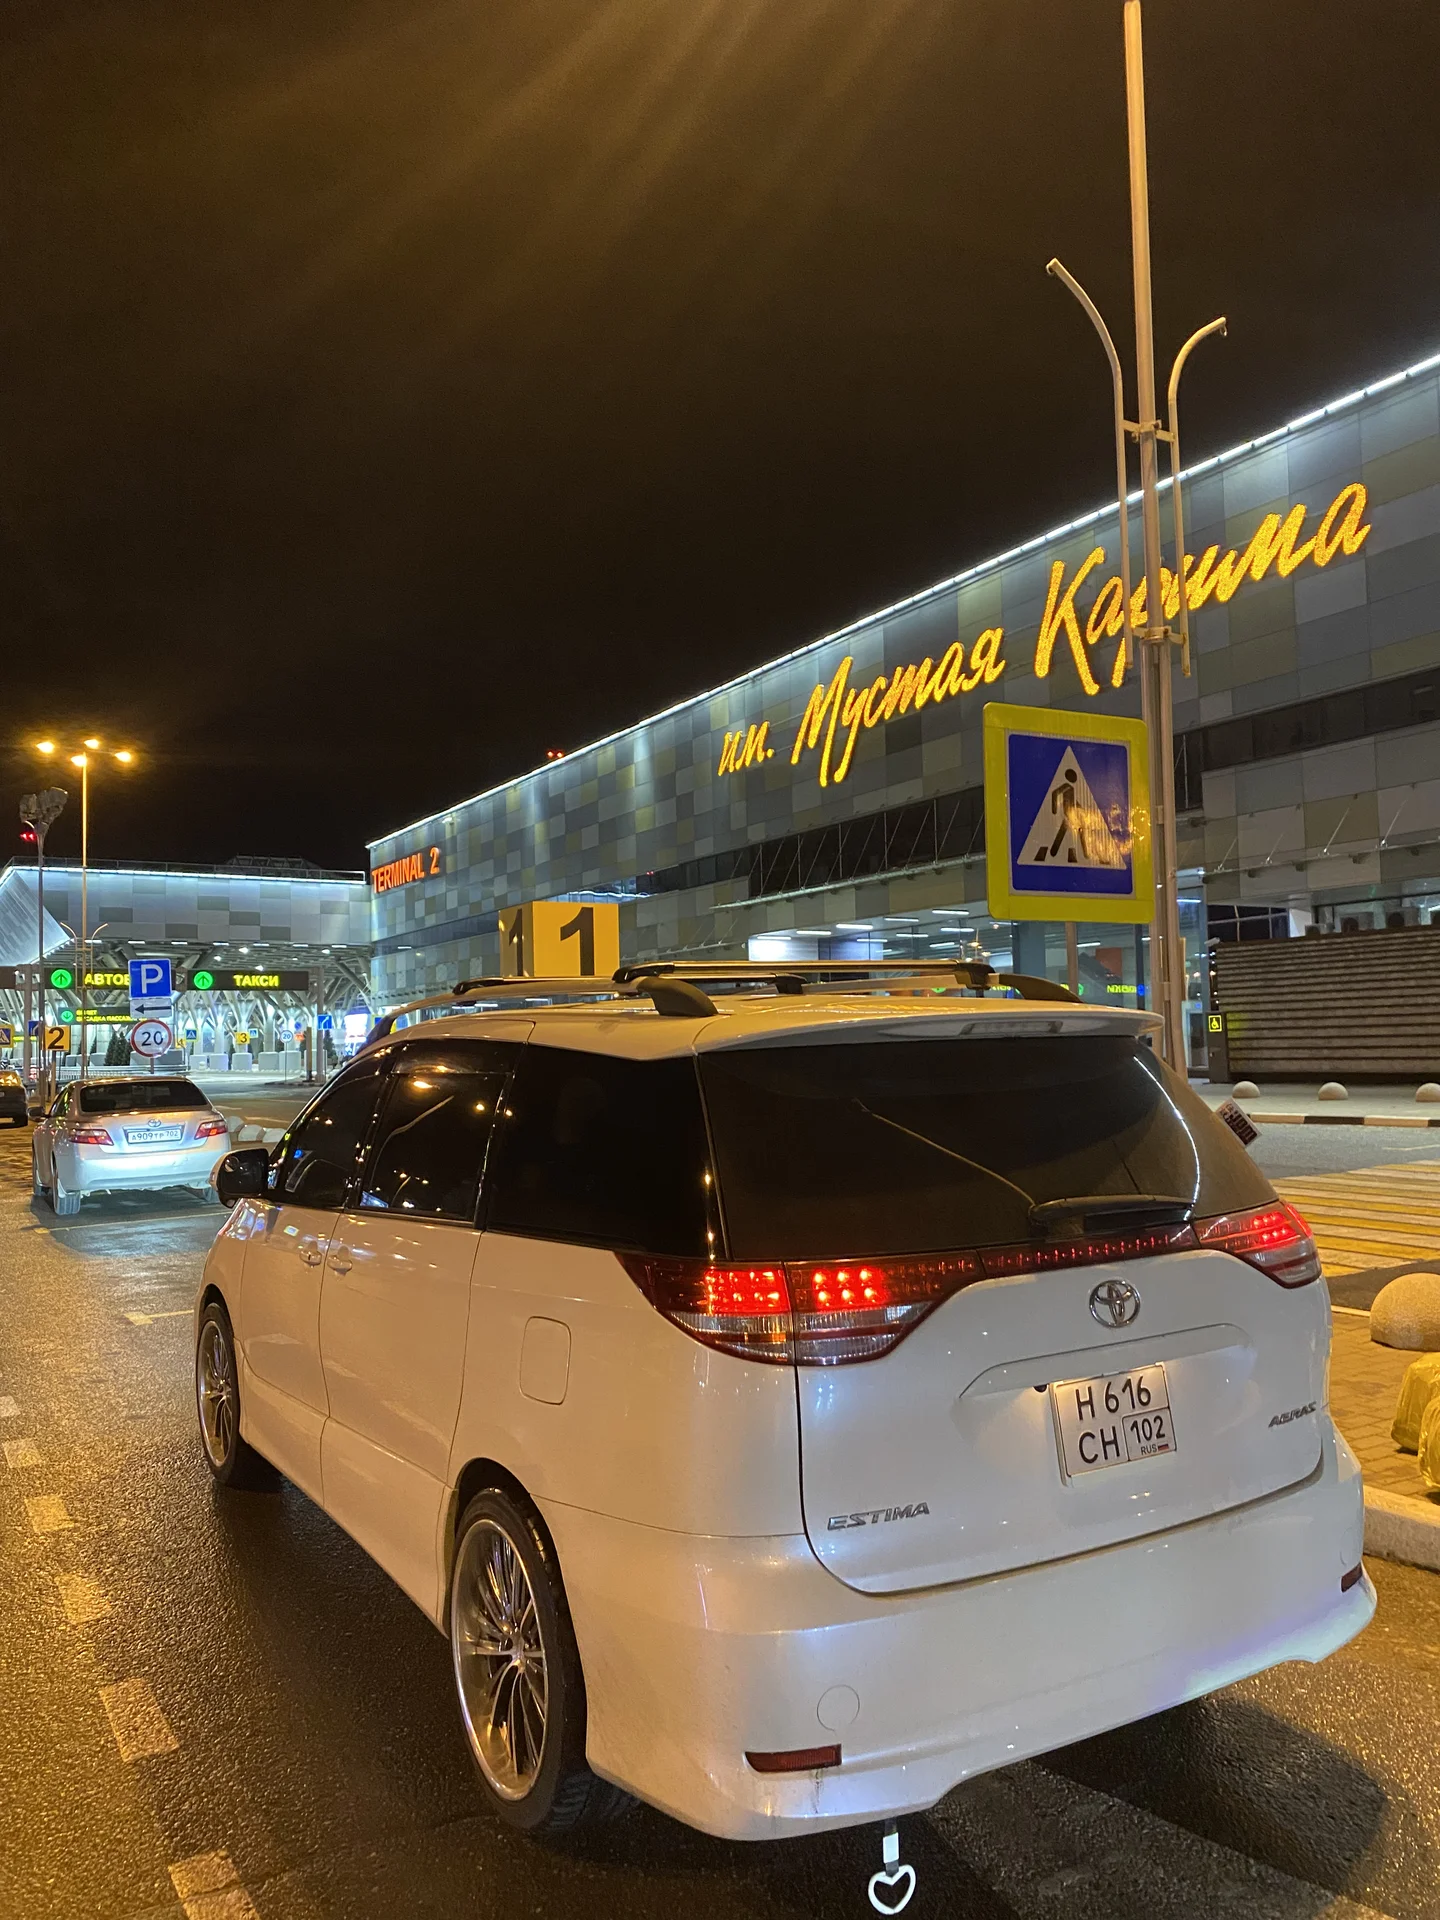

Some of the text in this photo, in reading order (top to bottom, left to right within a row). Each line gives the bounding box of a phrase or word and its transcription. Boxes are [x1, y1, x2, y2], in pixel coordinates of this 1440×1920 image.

[718, 482, 1371, 788] им. Мустая Карима
[371, 846, 441, 894] TERMINAL 2
[560, 906, 595, 976] 1
[233, 974, 279, 987] ТАКСИ
[47, 1026, 66, 1050] 2
[141, 1030, 164, 1047] 20
[240, 1032, 248, 1044] 3
[1104, 1375, 1152, 1413] 616
[1267, 1400, 1317, 1428] AERAS
[1130, 1415, 1166, 1444] 102
[1140, 1443, 1158, 1456] RUS
[826, 1501, 930, 1531] ESTIMA
